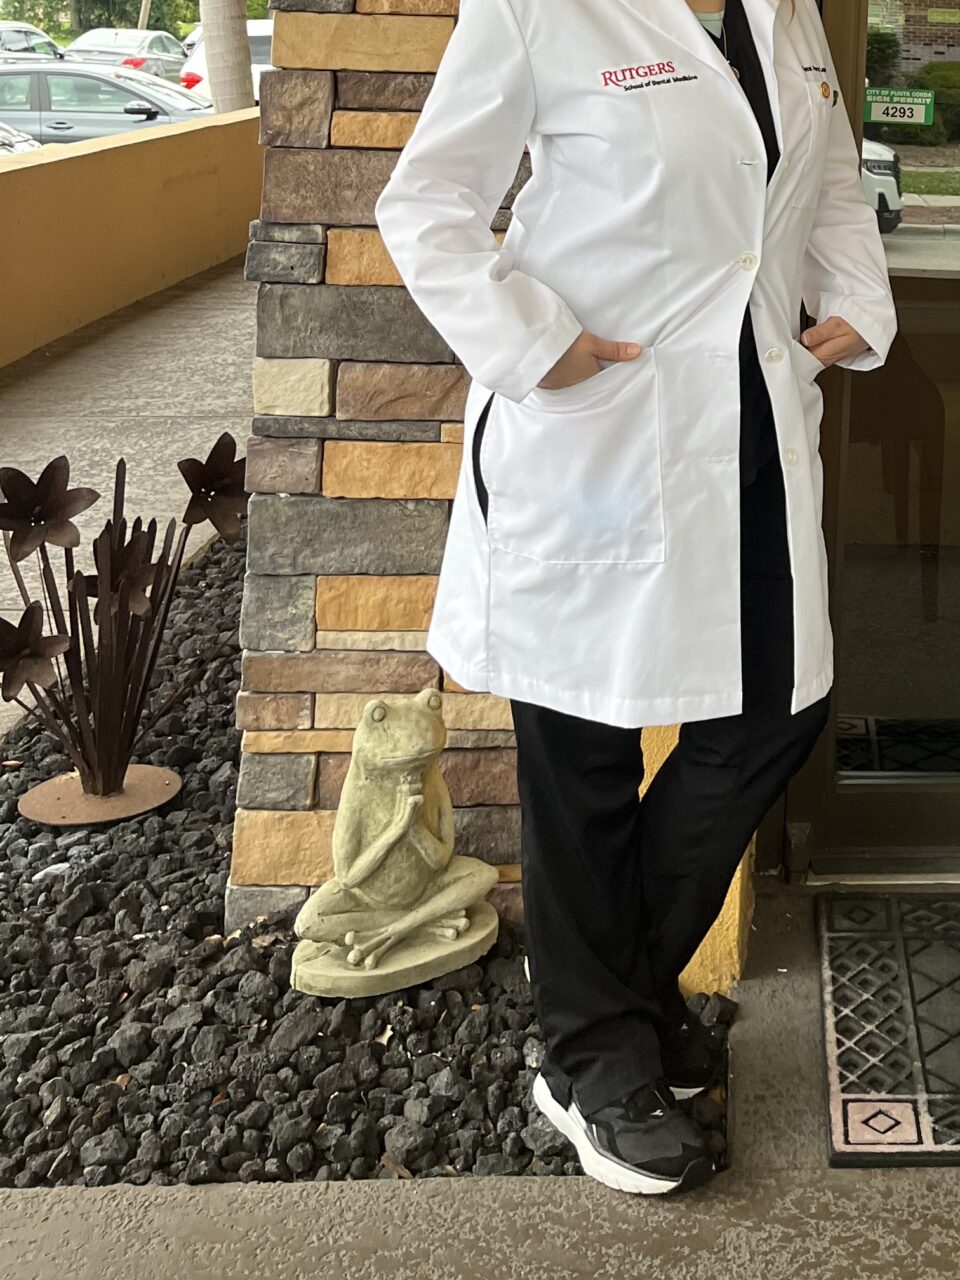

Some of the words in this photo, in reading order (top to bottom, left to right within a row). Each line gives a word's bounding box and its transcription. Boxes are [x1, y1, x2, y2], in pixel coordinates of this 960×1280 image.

[601, 61, 675, 87] RUTGERS
[623, 82, 644, 91] School
[652, 78, 671, 86] Dental
[672, 75, 698, 83] Medicine
[892, 96, 932, 105] PERMIT
[882, 106, 914, 119] 4293
